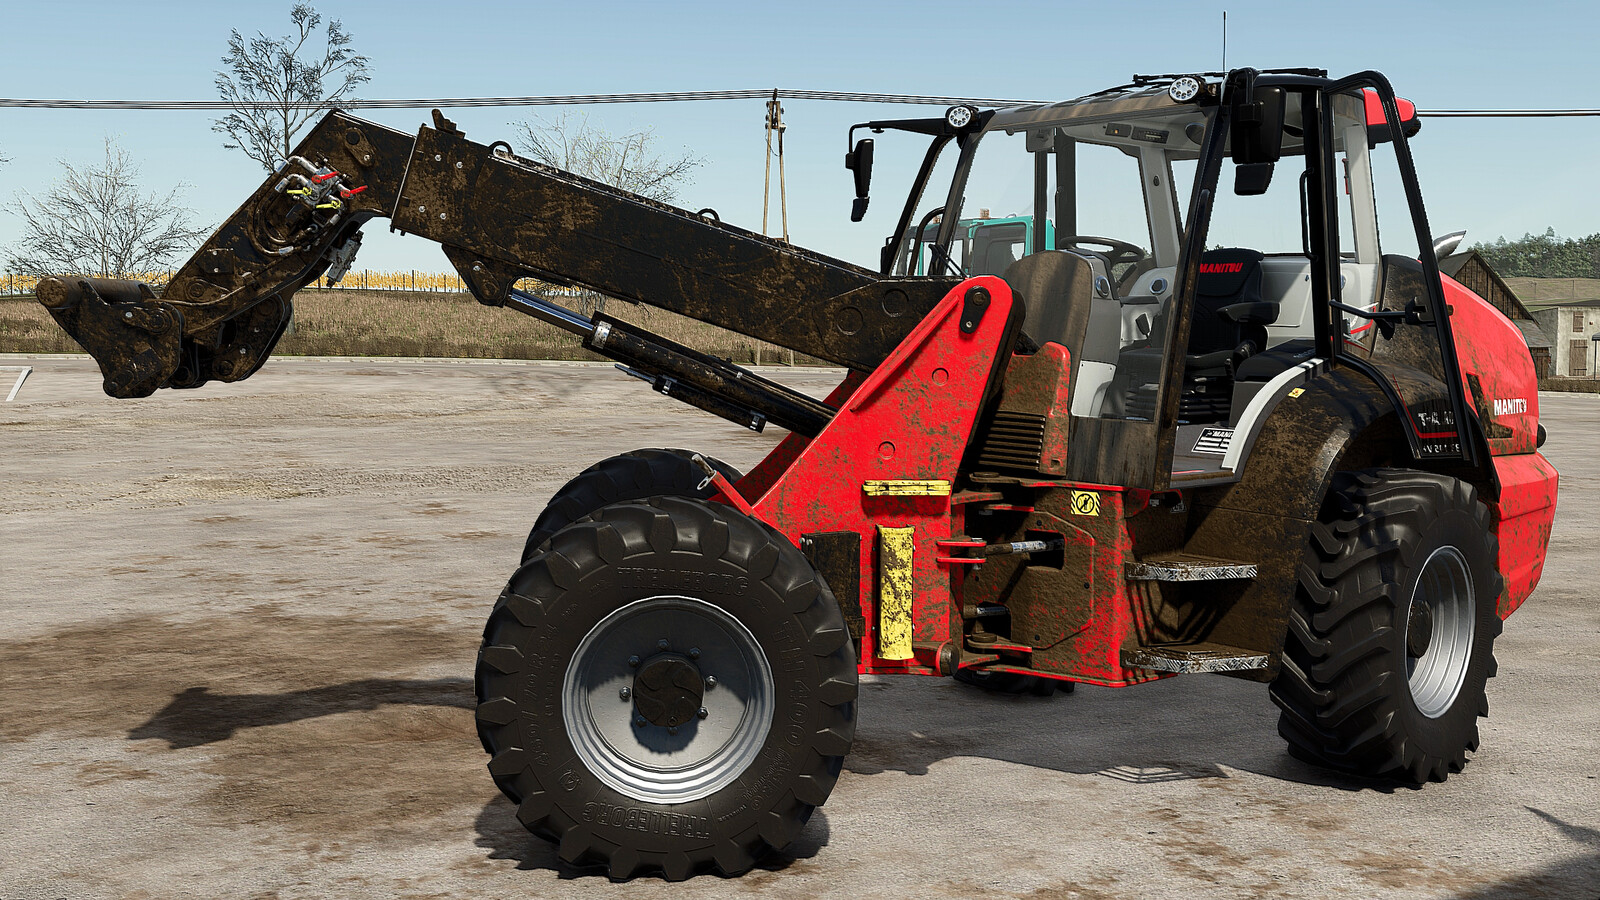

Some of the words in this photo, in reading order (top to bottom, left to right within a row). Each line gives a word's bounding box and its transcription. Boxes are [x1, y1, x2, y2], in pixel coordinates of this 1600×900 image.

[1199, 262, 1243, 273] MANITOU
[616, 567, 749, 597] TRELLEBORG
[581, 801, 711, 840] TRELLEBORG
